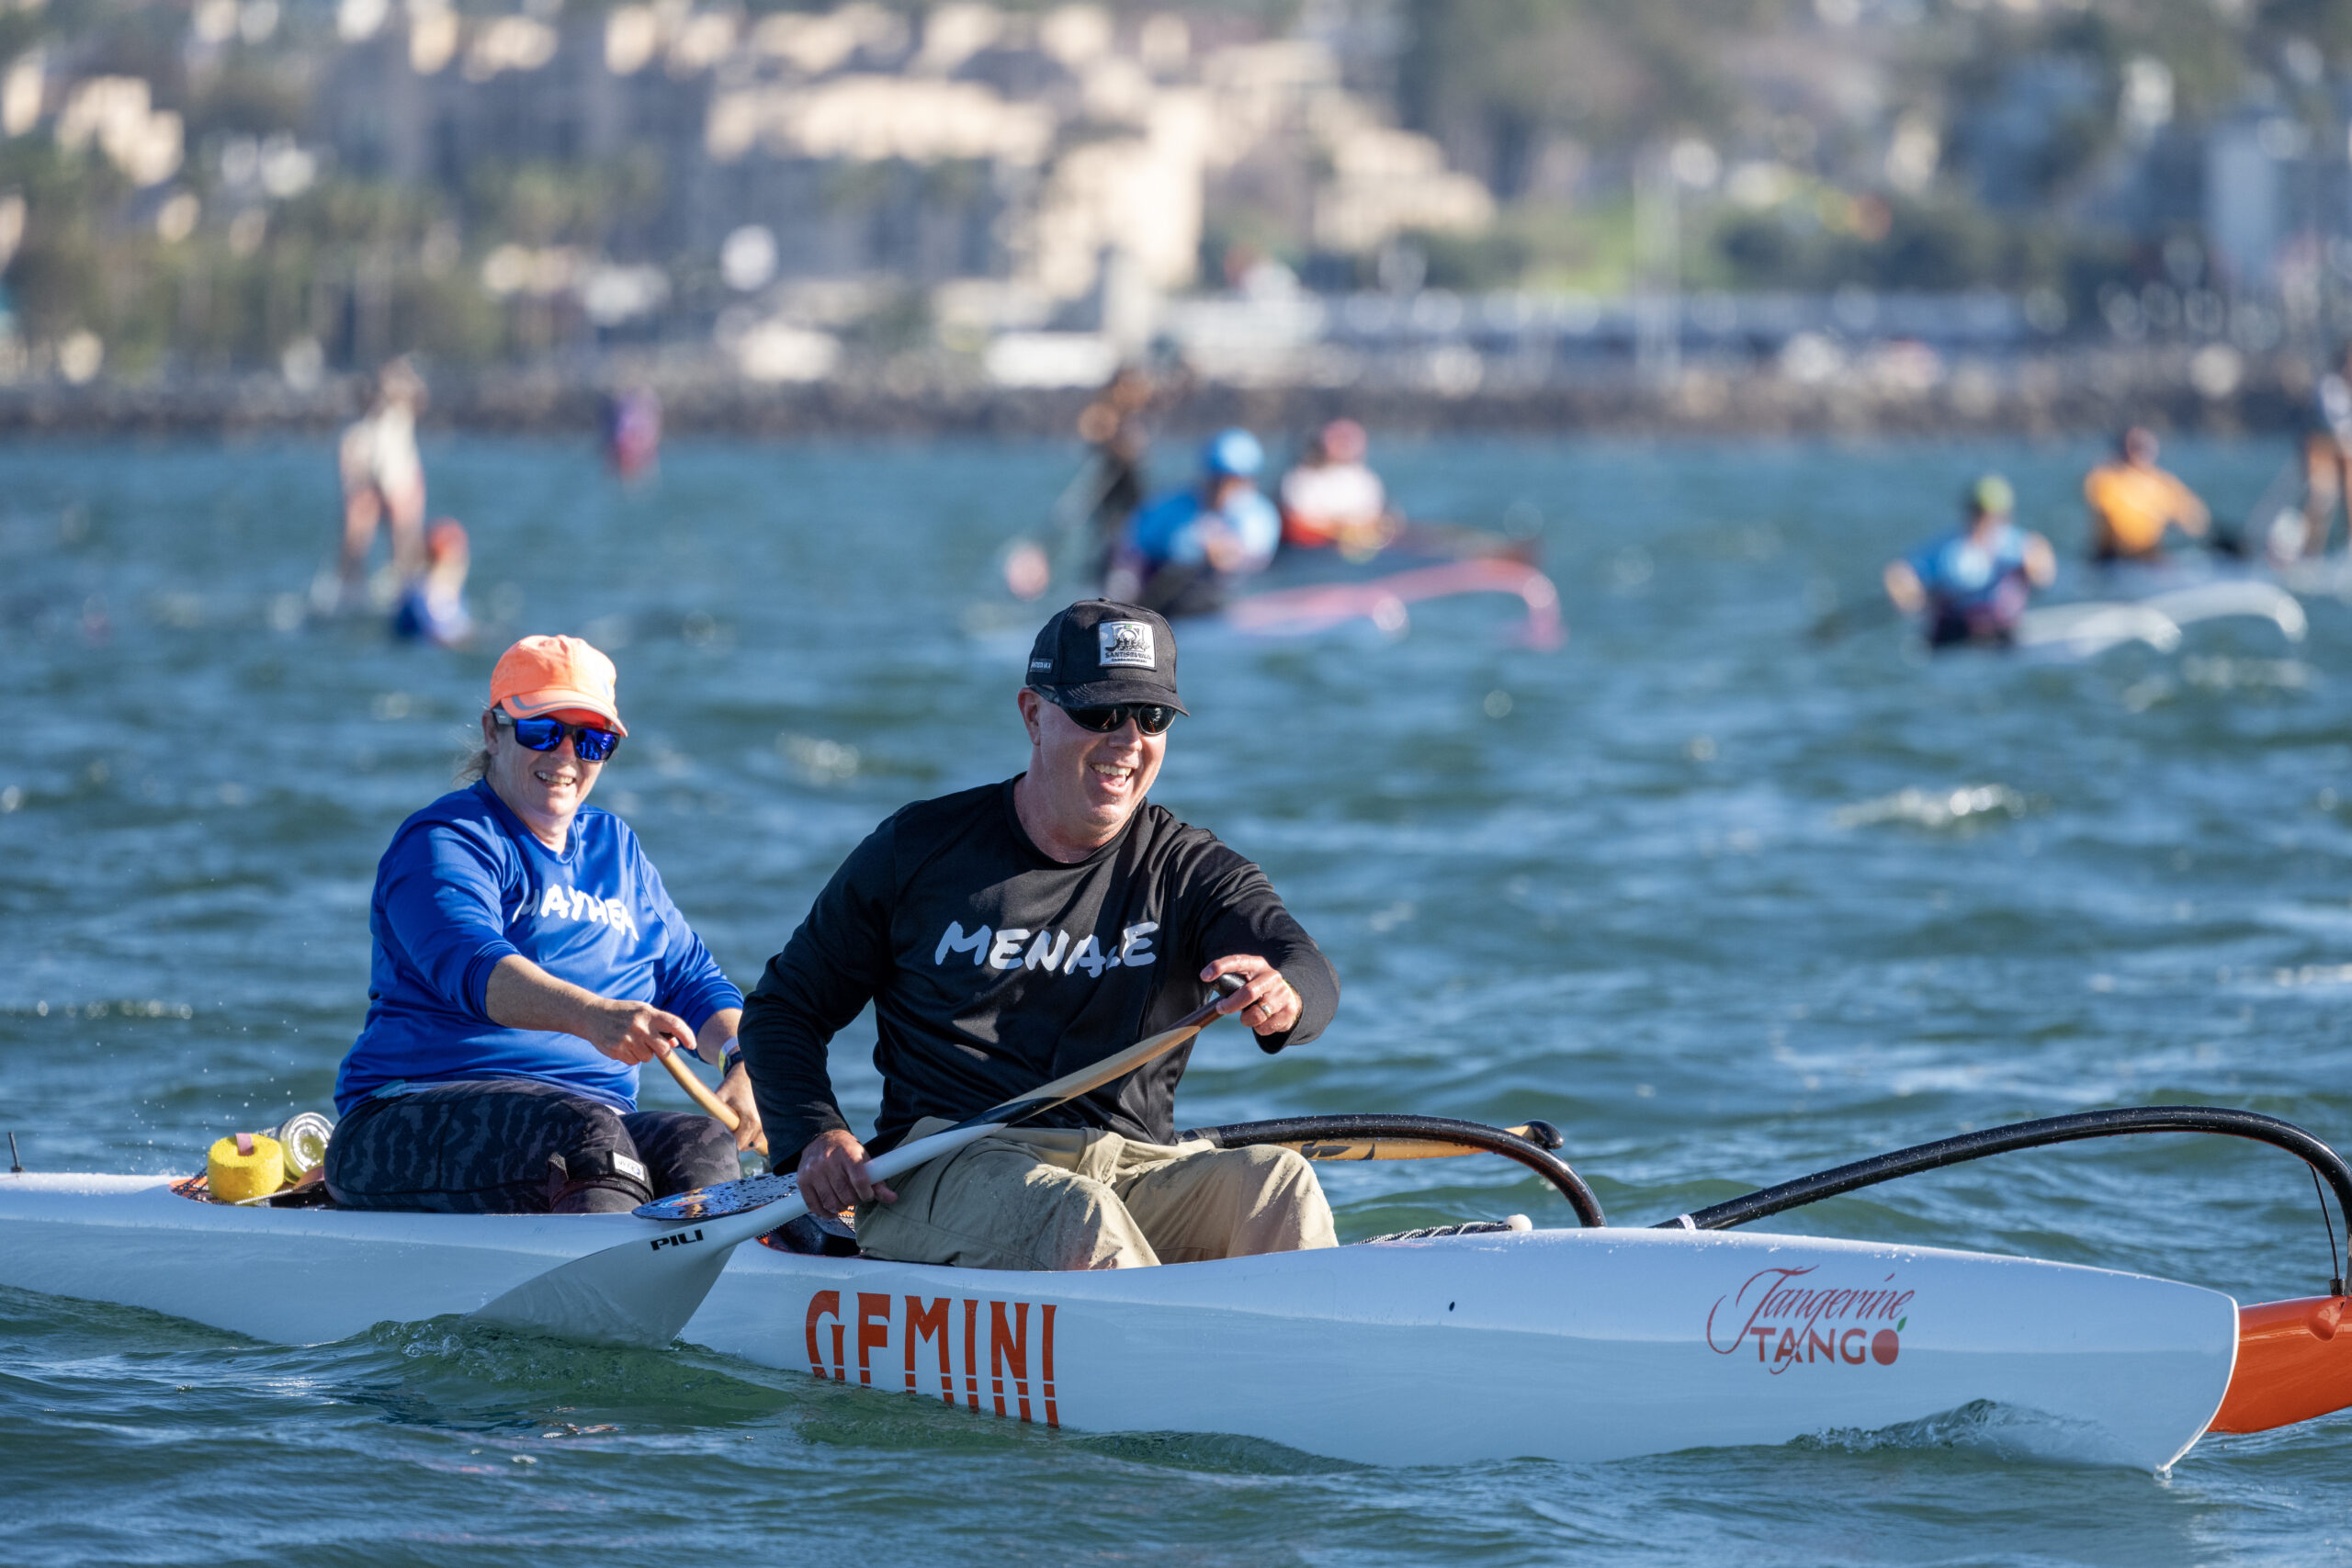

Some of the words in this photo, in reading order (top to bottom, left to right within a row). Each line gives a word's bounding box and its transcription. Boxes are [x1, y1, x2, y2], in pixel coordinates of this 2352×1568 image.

[650, 1229, 704, 1251] PILI
[1707, 1264, 1916, 1375] Tangerine
[1749, 1326, 1900, 1366] TANGO
